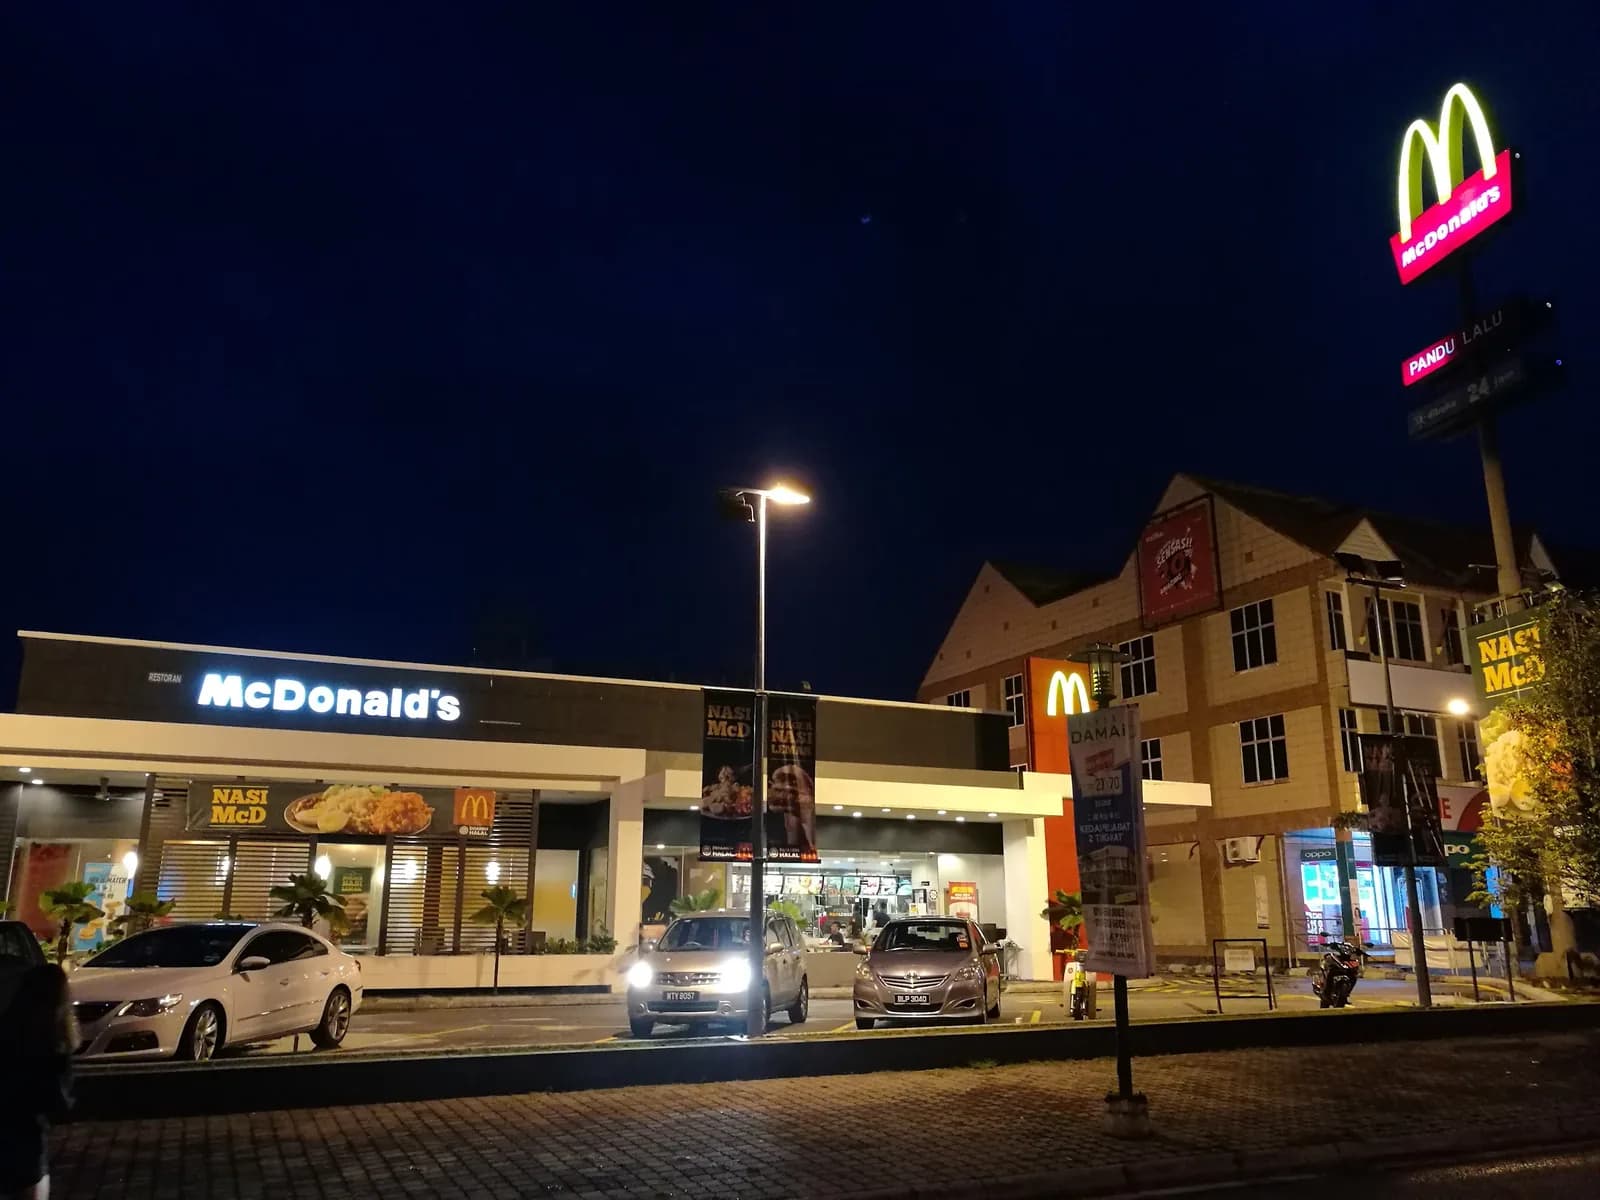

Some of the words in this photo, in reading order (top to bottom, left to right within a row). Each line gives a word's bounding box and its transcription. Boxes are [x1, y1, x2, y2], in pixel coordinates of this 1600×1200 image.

[1402, 186, 1500, 268] McDonald's
[1409, 338, 1455, 376] PANDU
[1462, 309, 1503, 345] LALU
[148, 672, 182, 684] RESTORAN
[1483, 655, 1545, 693] McD
[197, 673, 461, 721] McDonald's
[707, 705, 751, 719] NASI
[706, 720, 750, 738] McD
[770, 730, 813, 744] NASI
[211, 788, 269, 804] NASI
[210, 805, 267, 824] McD
